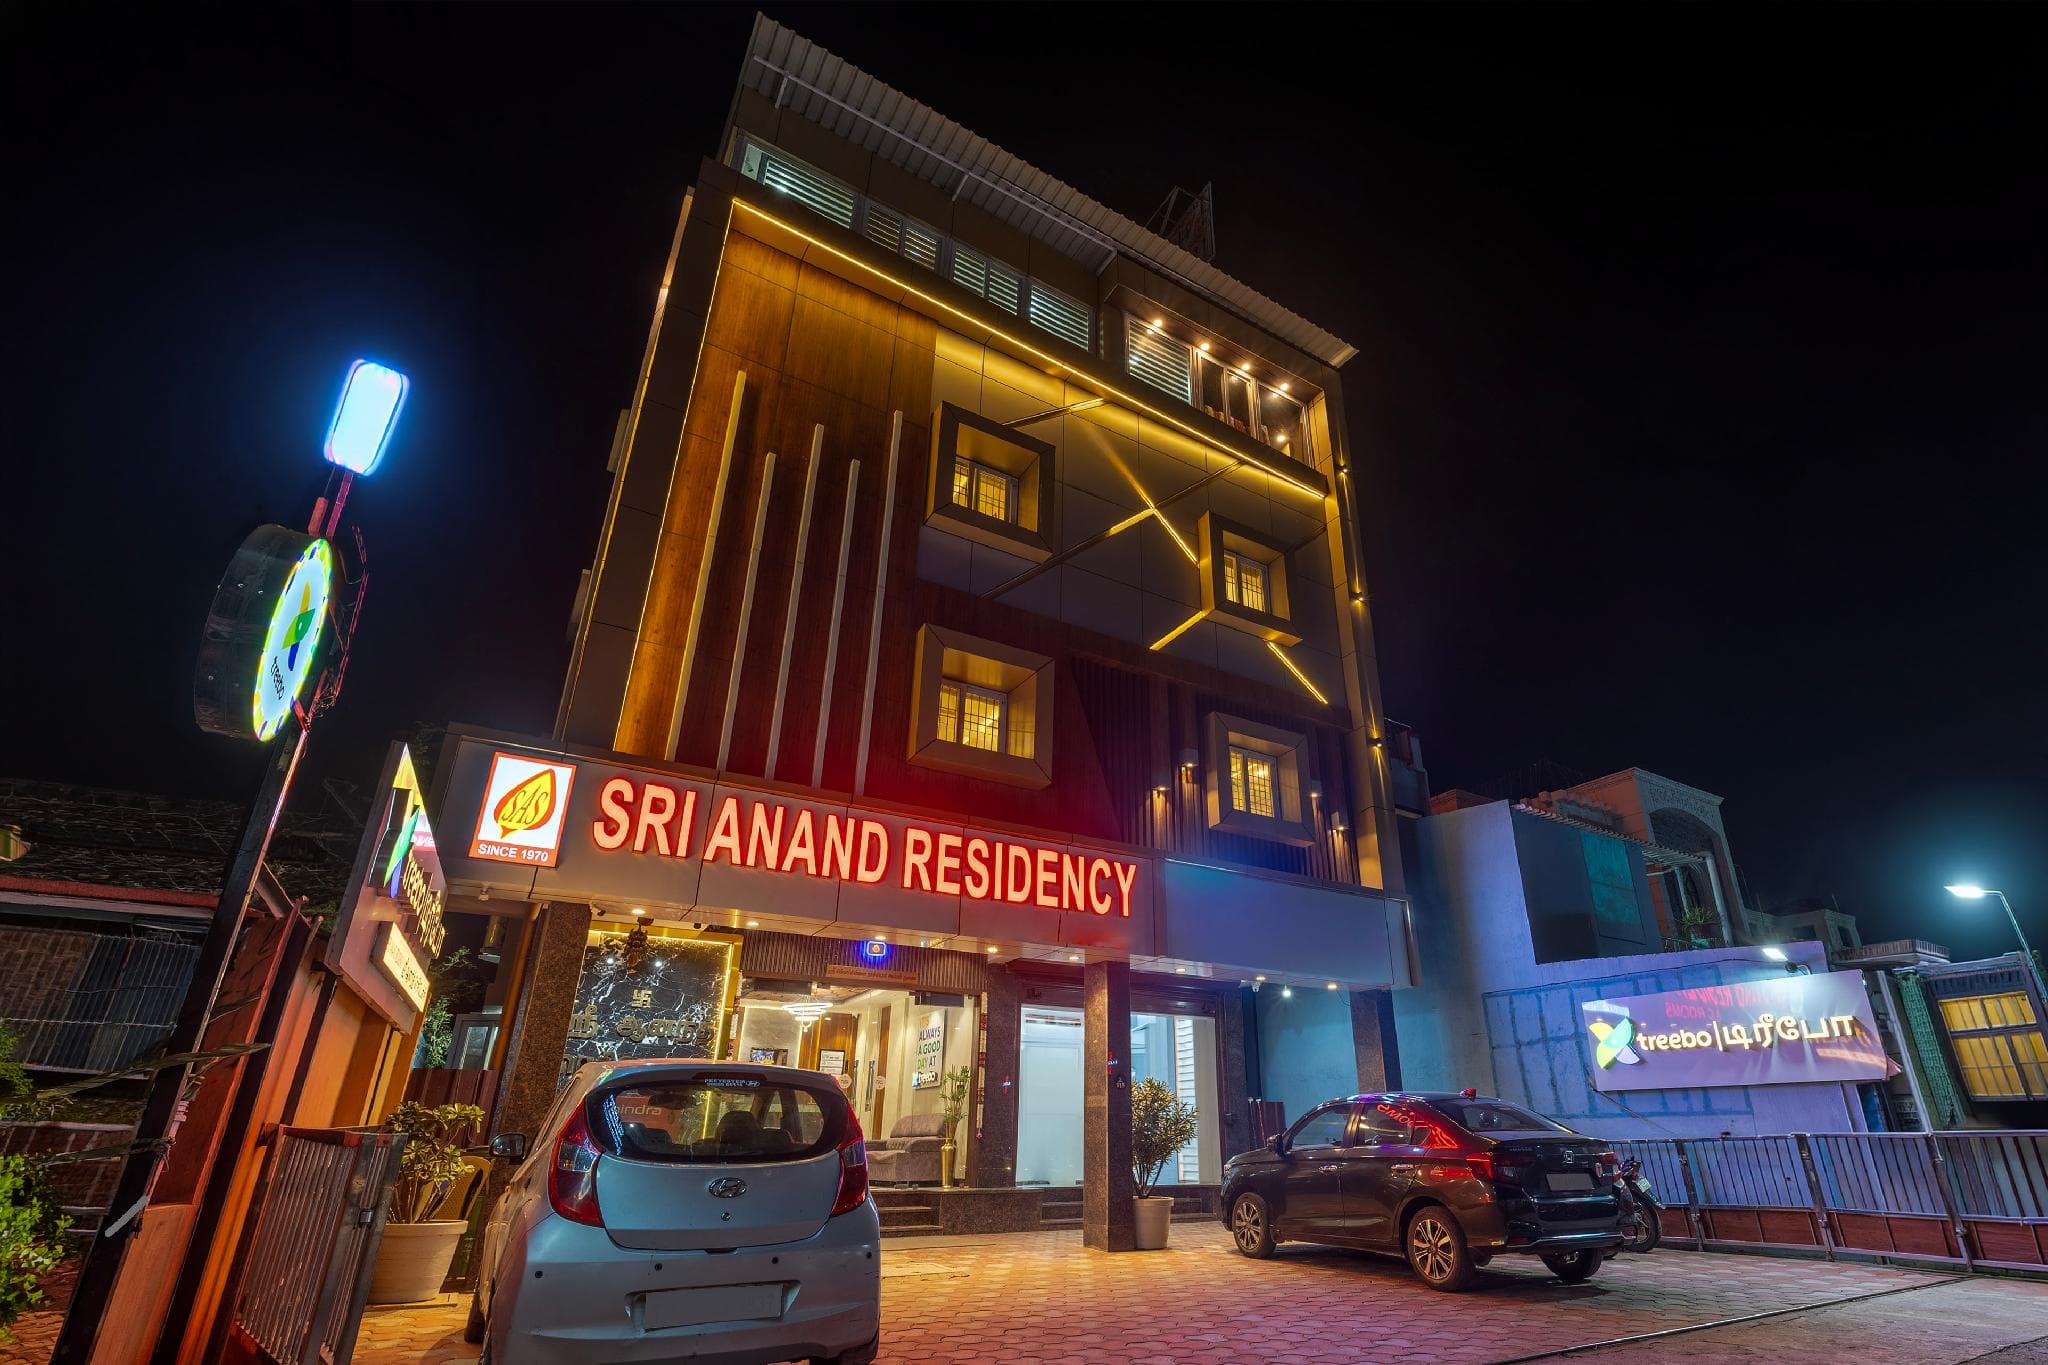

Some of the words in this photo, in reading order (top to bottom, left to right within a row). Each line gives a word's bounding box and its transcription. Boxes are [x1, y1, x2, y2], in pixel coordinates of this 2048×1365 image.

[501, 785, 548, 825] SAS
[478, 843, 518, 858] SINCE
[521, 848, 549, 862] 1970
[593, 777, 697, 859] SRI
[703, 797, 890, 884] ANAND
[902, 828, 1138, 917] RESIDENCY
[919, 1027, 941, 1042] ALWAYS
[1636, 1029, 1713, 1051] treebo
[918, 1044, 922, 1056] A
[923, 1041, 941, 1055] GOOD
[929, 1055, 936, 1069] AT
